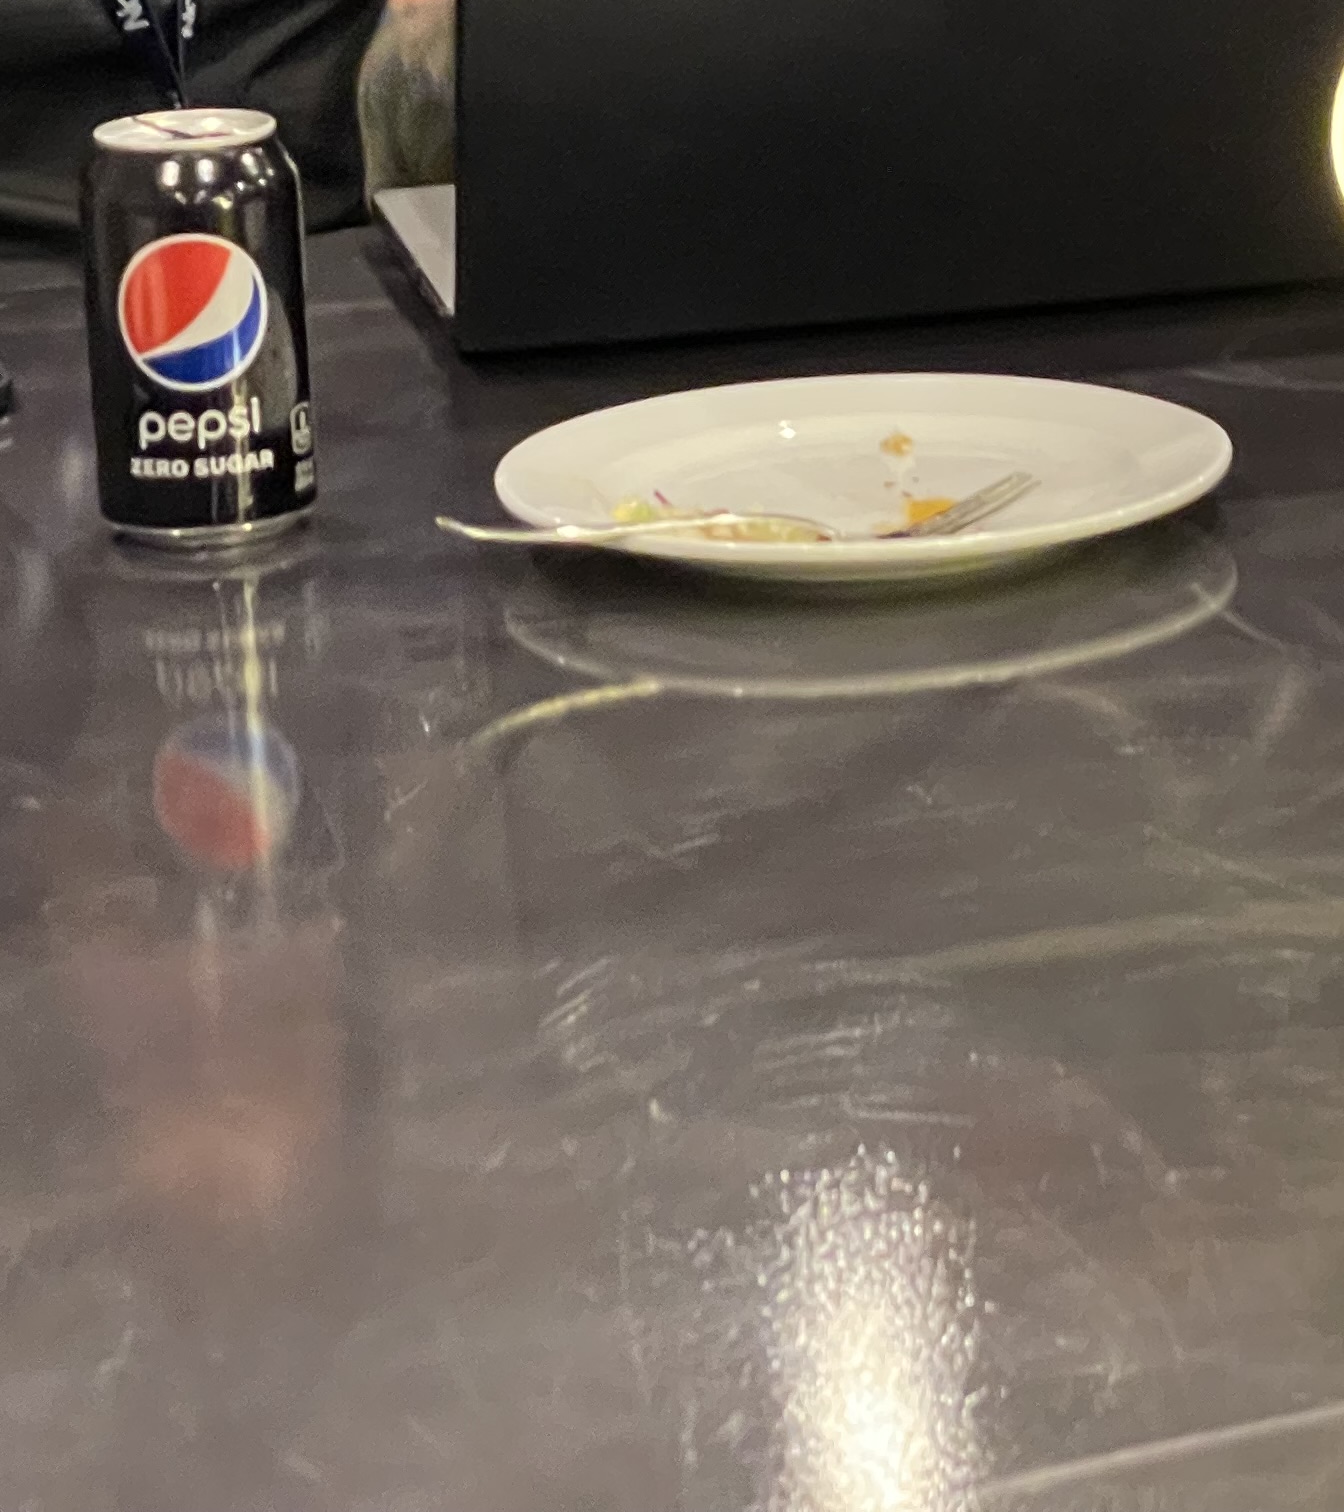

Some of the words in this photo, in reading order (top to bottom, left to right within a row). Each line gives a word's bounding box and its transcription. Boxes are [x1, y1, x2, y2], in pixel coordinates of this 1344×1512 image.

[138, 396, 262, 451] pepsi
[130, 456, 190, 479] ZERO
[194, 448, 274, 478] SUGAR
